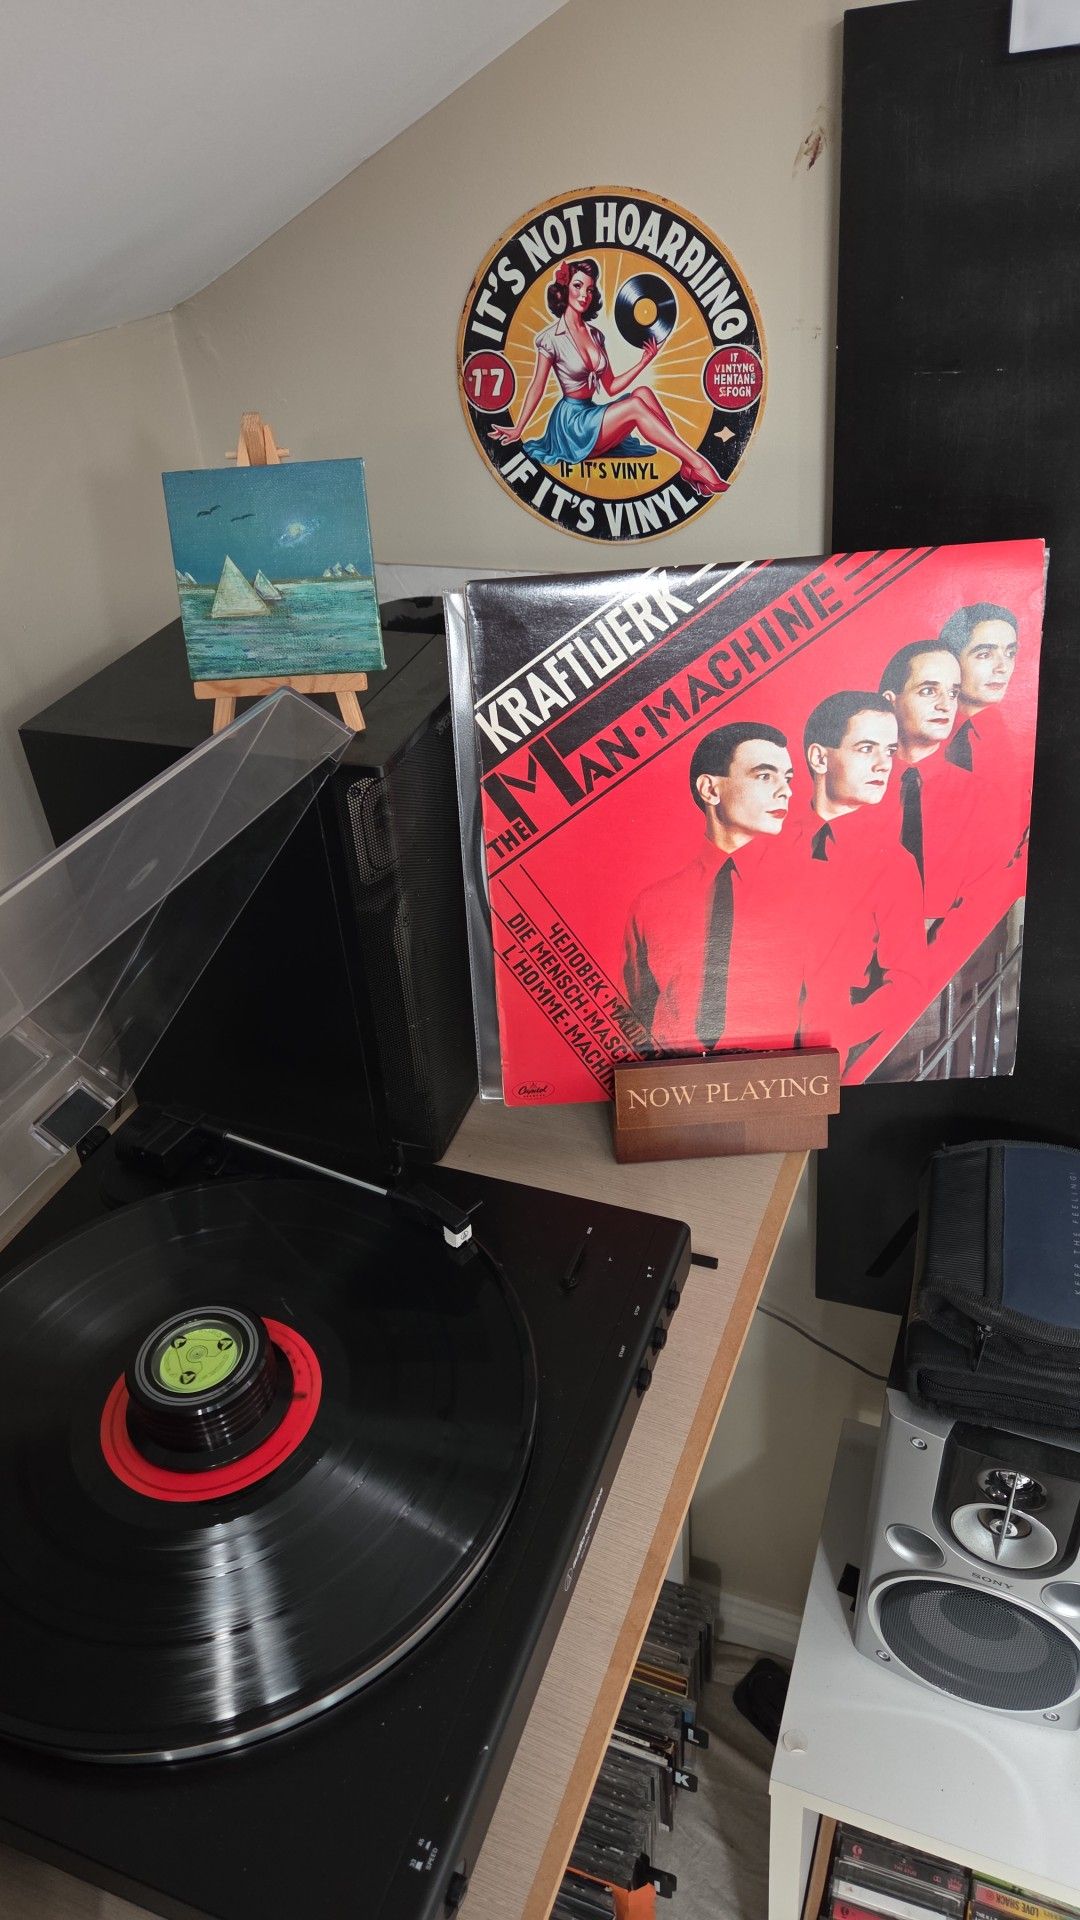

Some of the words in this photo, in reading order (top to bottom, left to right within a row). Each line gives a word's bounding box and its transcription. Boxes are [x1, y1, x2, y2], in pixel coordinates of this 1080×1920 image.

[471, 256, 526, 343] IT'S
[518, 204, 584, 272] NOT
[560, 462, 574, 478] IF
[580, 462, 608, 479] IT'S
[611, 462, 659, 480] VINYL
[500, 451, 538, 484] IF
[531, 477, 596, 533] IT'S
[603, 484, 699, 537] VINYL
[474, 570, 694, 755] KRAFTWERK
[486, 817, 533, 860] THE
[507, 912, 537, 943] DIE
[627, 1084, 697, 1110] NOW
[705, 1075, 830, 1104] PLAYING
[971, 1572, 1014, 1589] SONY
[675, 1771, 690, 1788] K
